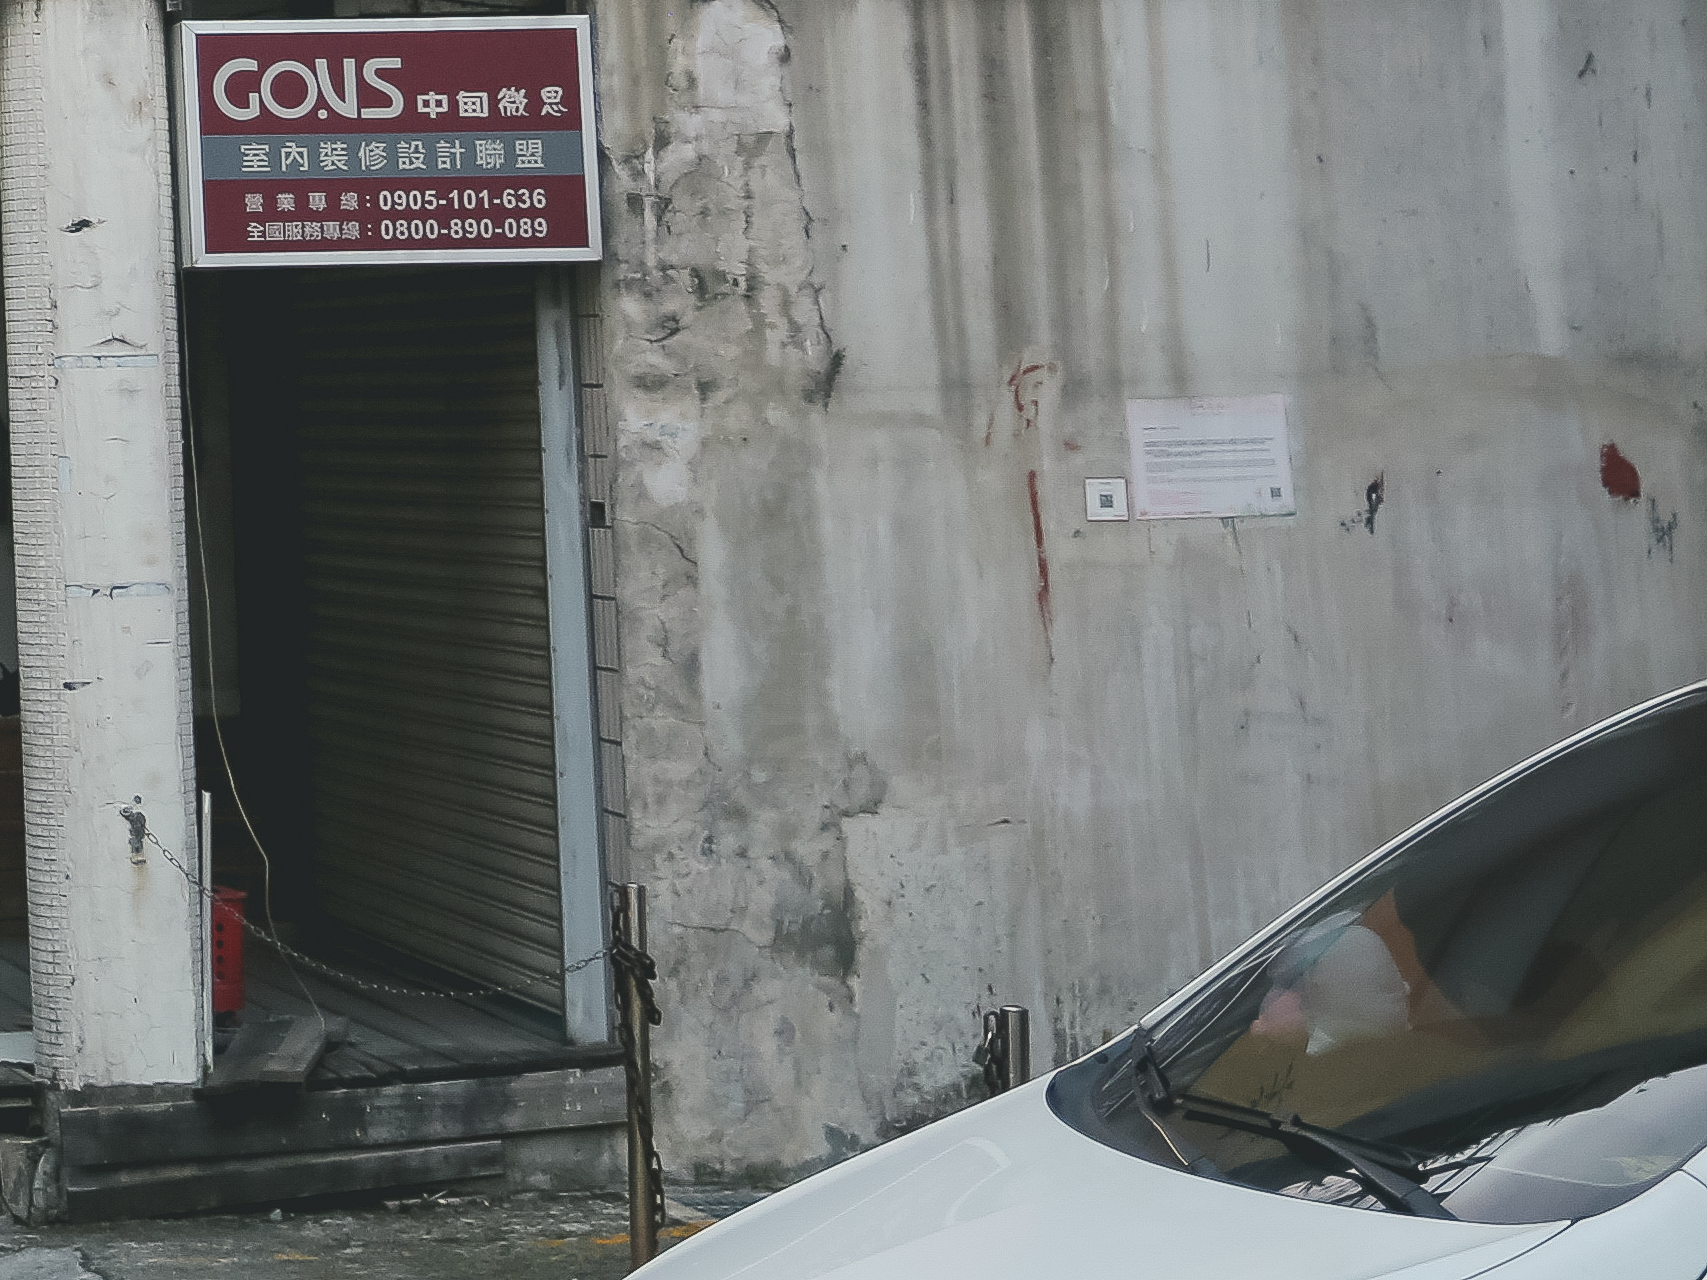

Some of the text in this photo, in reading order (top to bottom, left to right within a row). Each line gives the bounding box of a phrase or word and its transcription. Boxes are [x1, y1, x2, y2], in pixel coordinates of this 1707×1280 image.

[239, 138, 546, 174] 室內裝修設計聯盟
